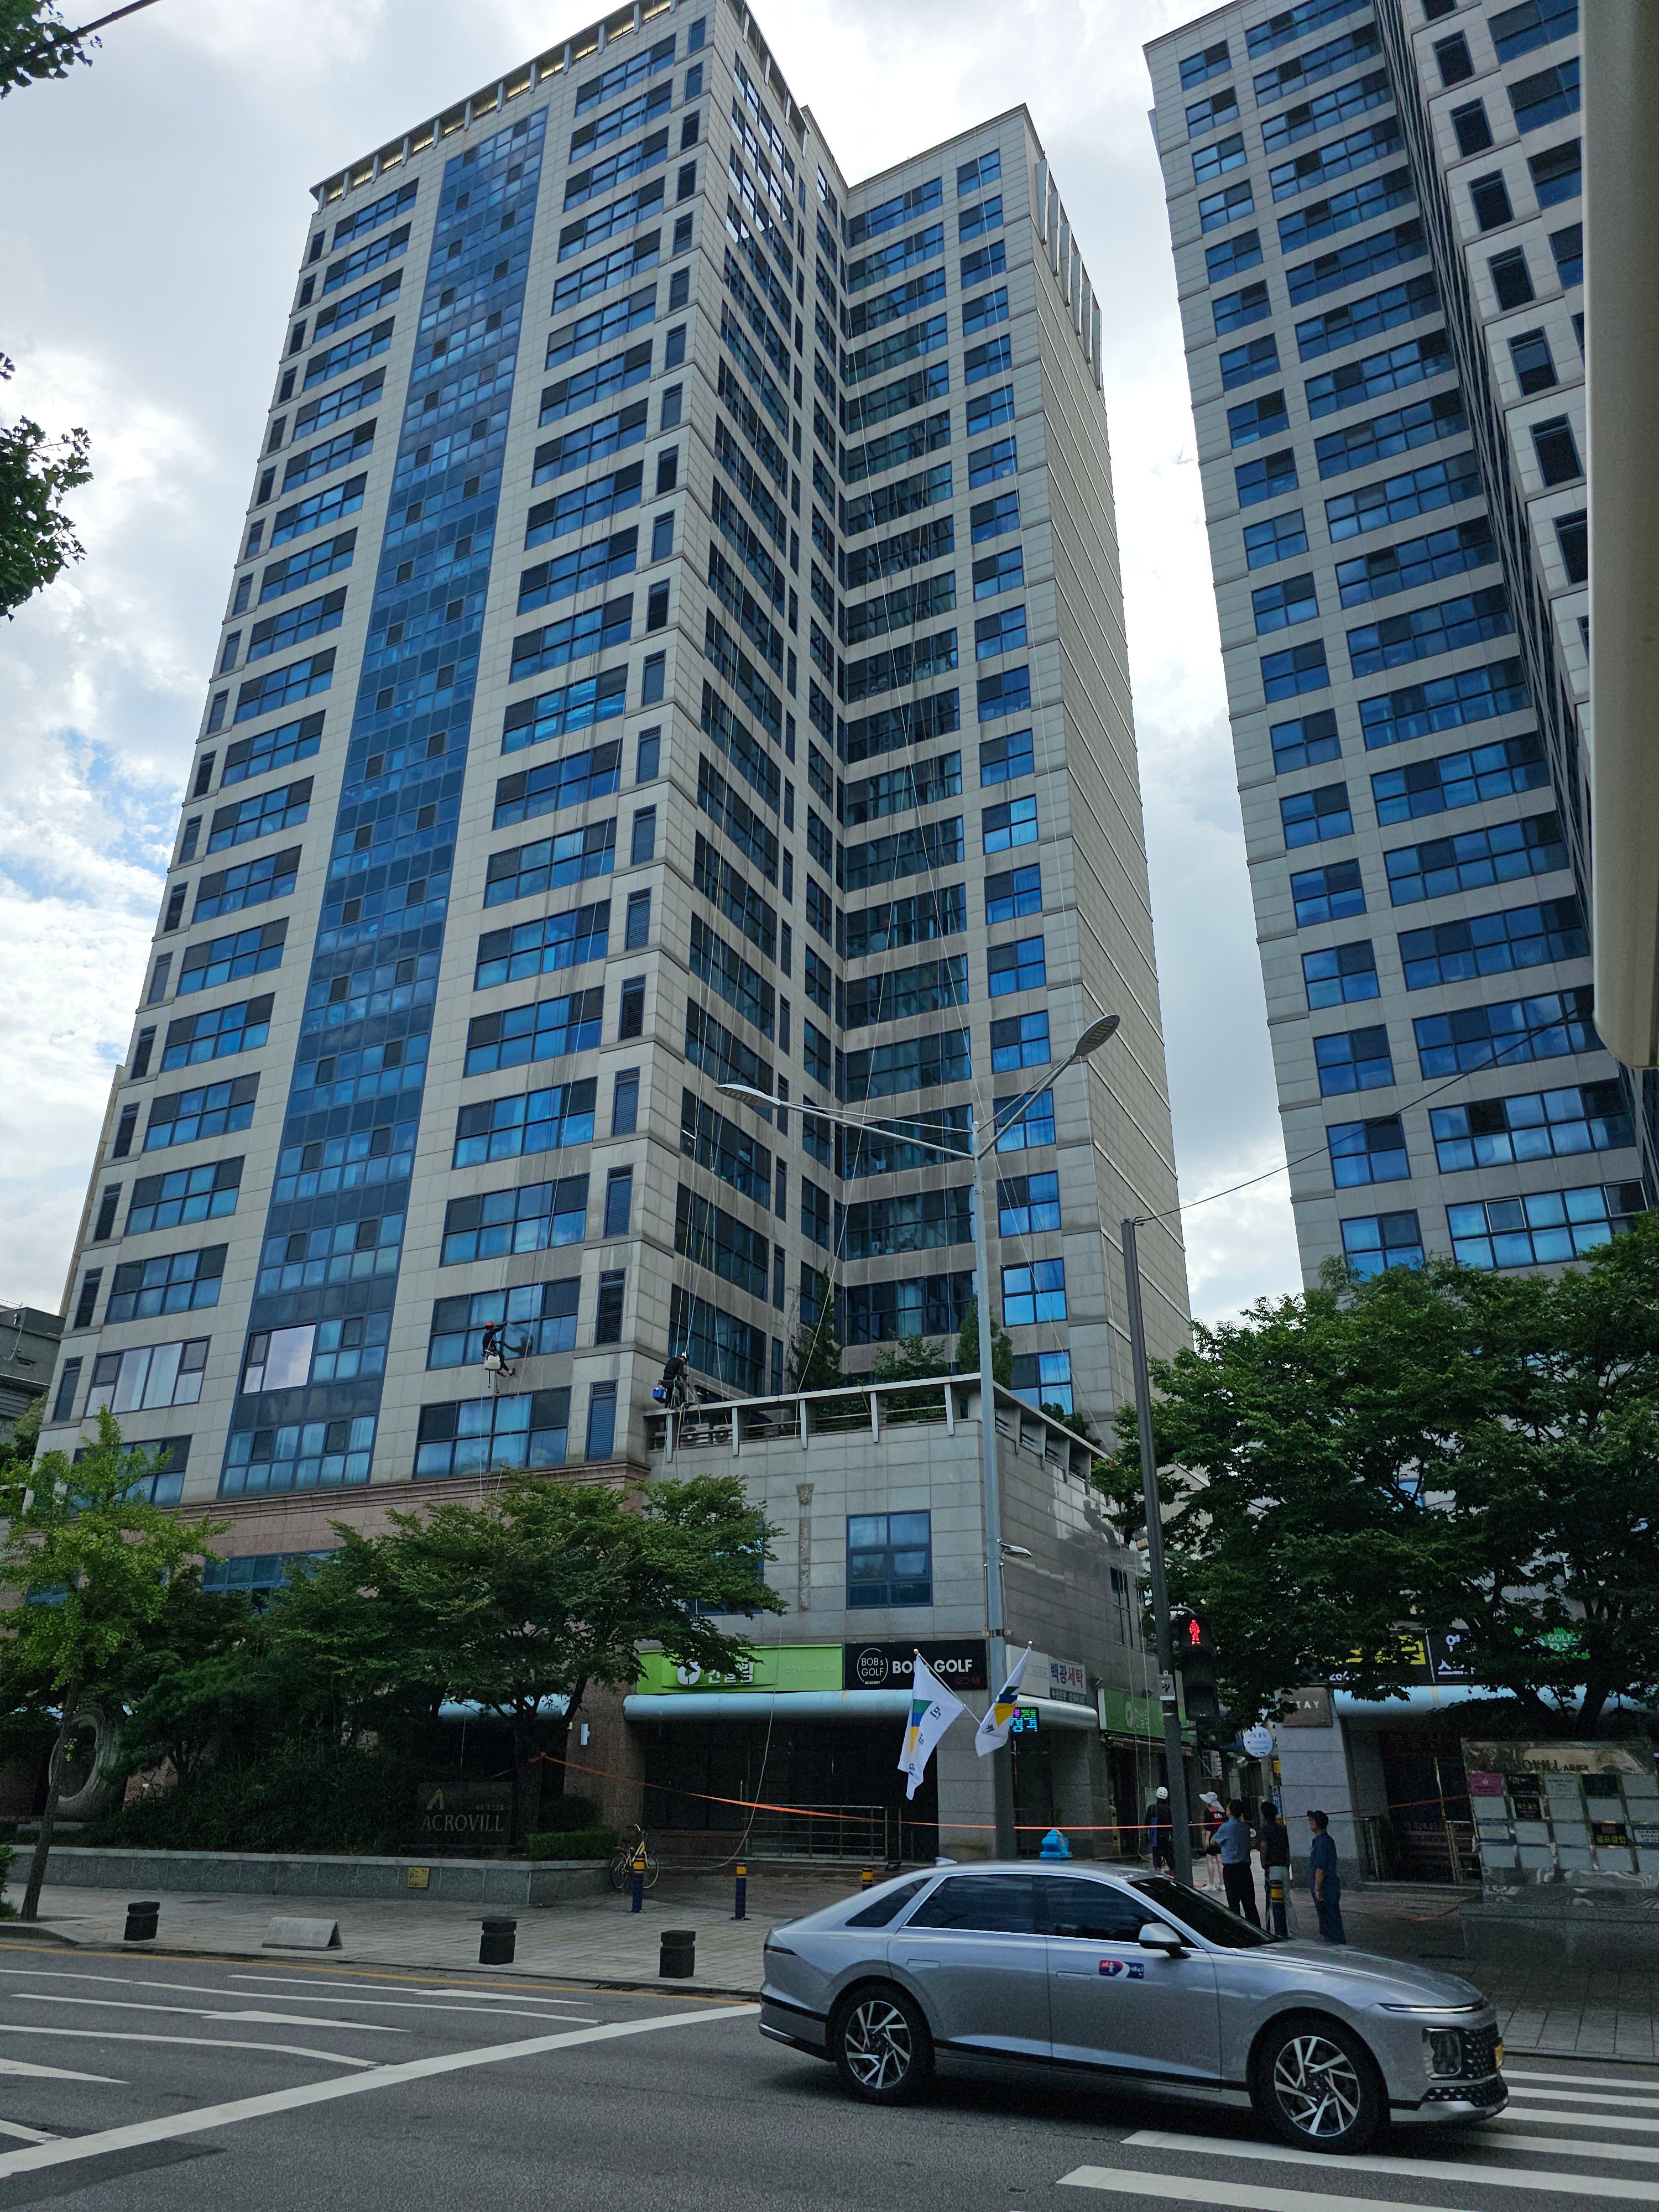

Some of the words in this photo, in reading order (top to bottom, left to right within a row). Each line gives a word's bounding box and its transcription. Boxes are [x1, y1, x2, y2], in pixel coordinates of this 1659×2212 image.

[861, 1667, 884, 1676] GOLF
[934, 1659, 973, 1673] GOLF
[1289, 1700, 1319, 1709] TAY
[420, 1814, 505, 1832] ACROVILL
